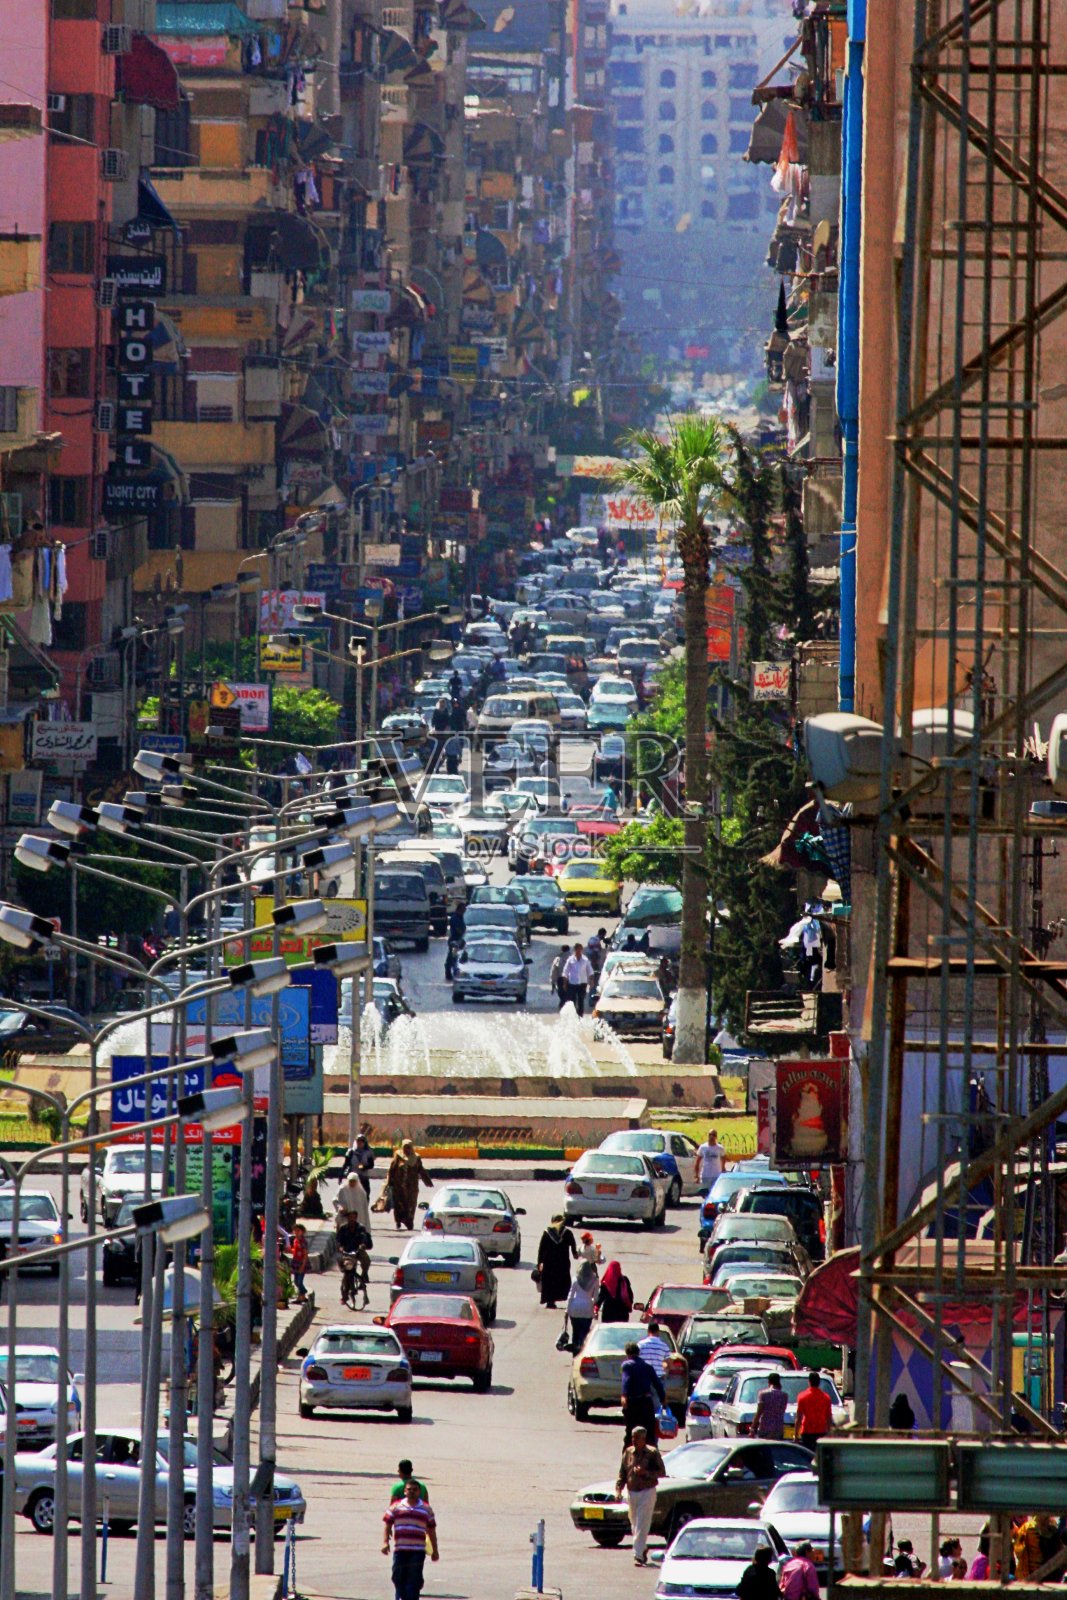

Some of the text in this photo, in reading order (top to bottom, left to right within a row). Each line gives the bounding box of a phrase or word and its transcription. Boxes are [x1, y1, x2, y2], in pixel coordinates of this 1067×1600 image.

[125, 308, 147, 465] HOTEL
[107, 485, 158, 499] LIGHT CITY
